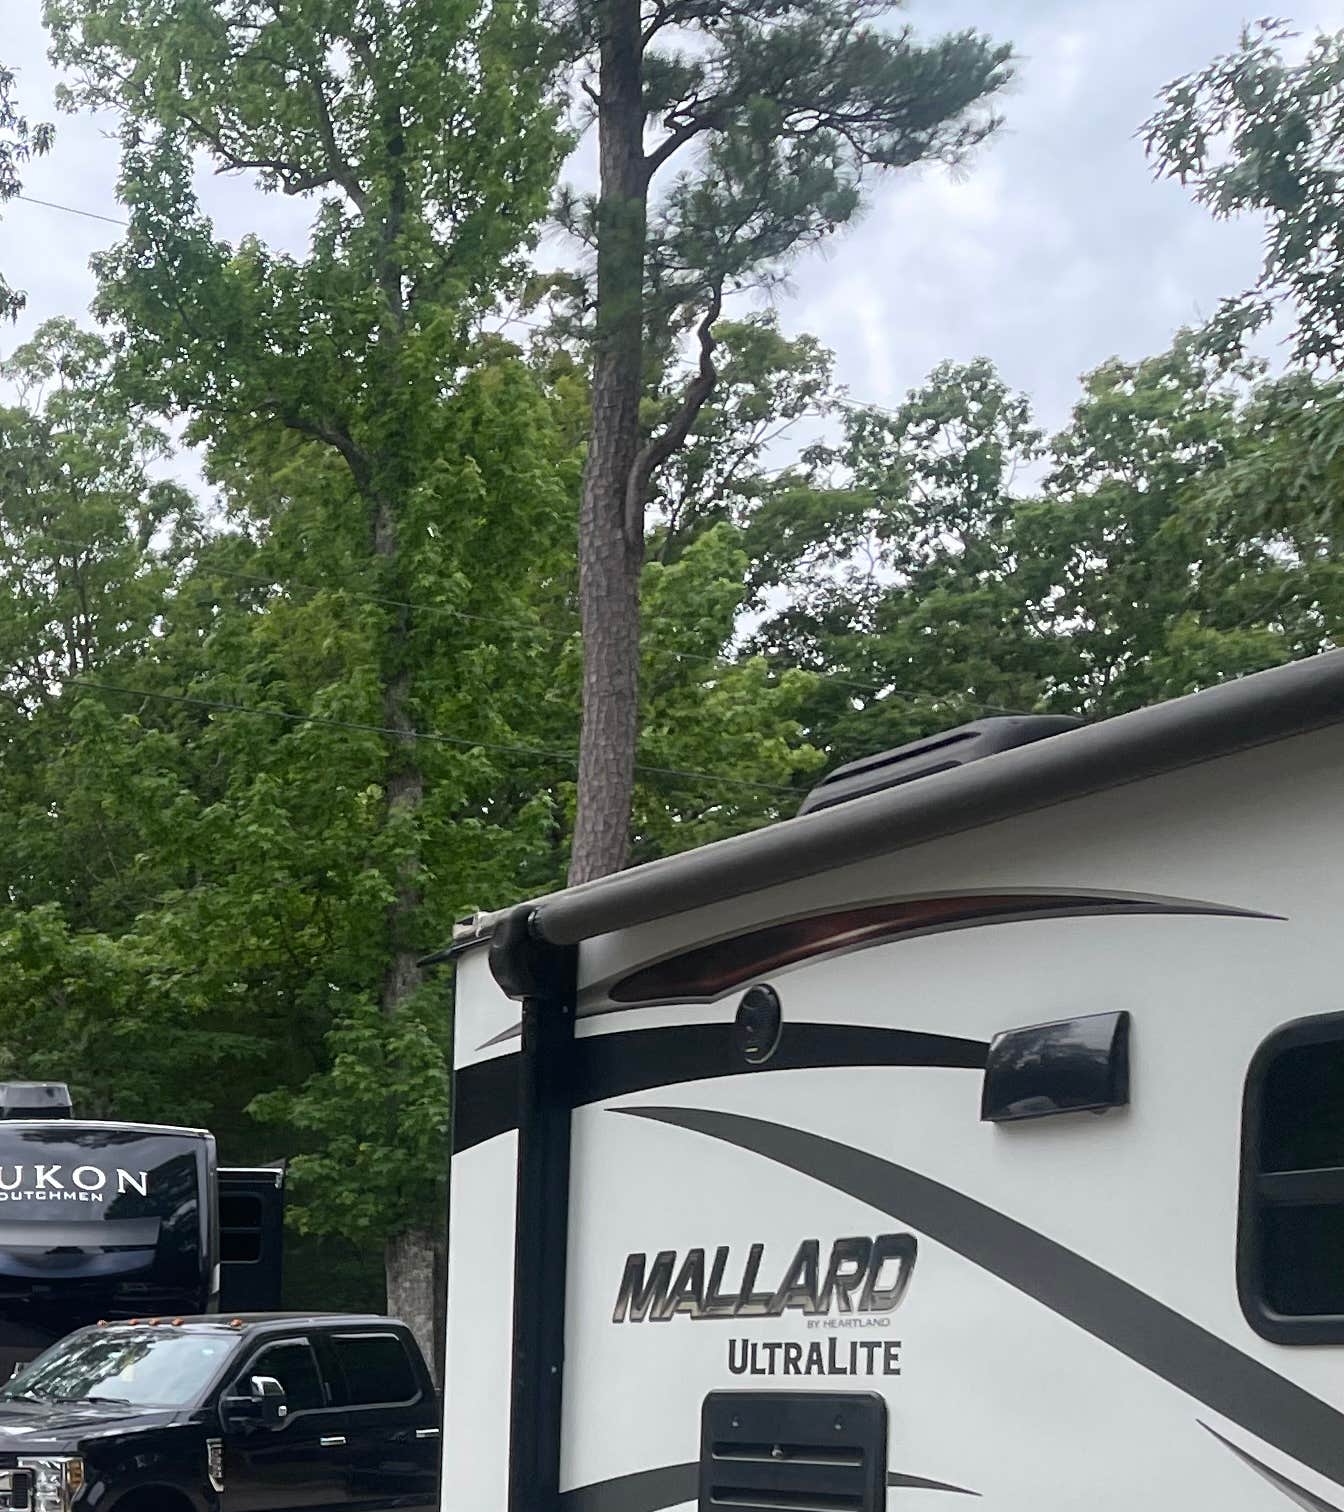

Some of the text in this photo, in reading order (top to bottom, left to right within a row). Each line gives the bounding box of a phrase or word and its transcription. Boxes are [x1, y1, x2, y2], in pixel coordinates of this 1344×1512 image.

[612, 1232, 918, 1323] MALLARD
[806, 1317, 891, 1329] BY HEARTLAND
